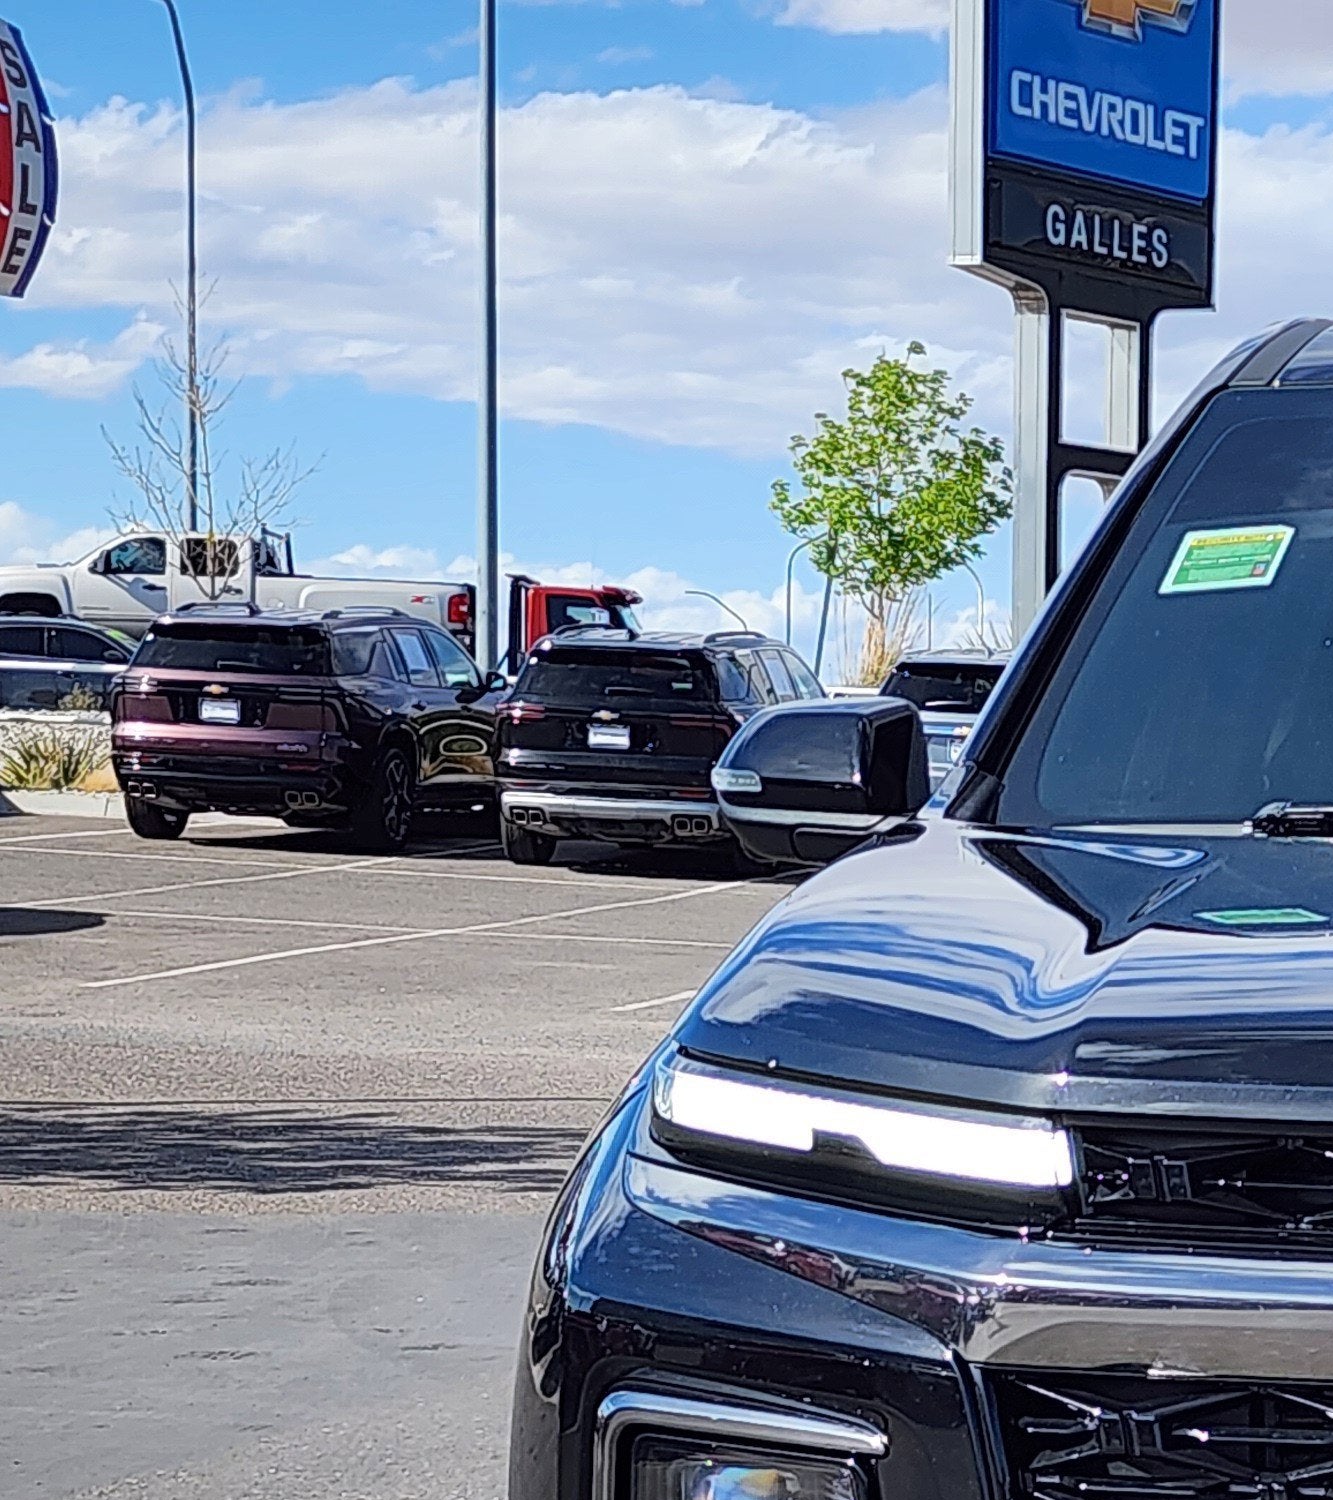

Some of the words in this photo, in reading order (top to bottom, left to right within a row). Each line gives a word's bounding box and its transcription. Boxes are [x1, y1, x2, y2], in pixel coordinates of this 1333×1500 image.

[0, 39, 42, 275] SALE
[1010, 69, 1205, 160] CHEVROLET
[1045, 203, 1170, 269] GALLES
